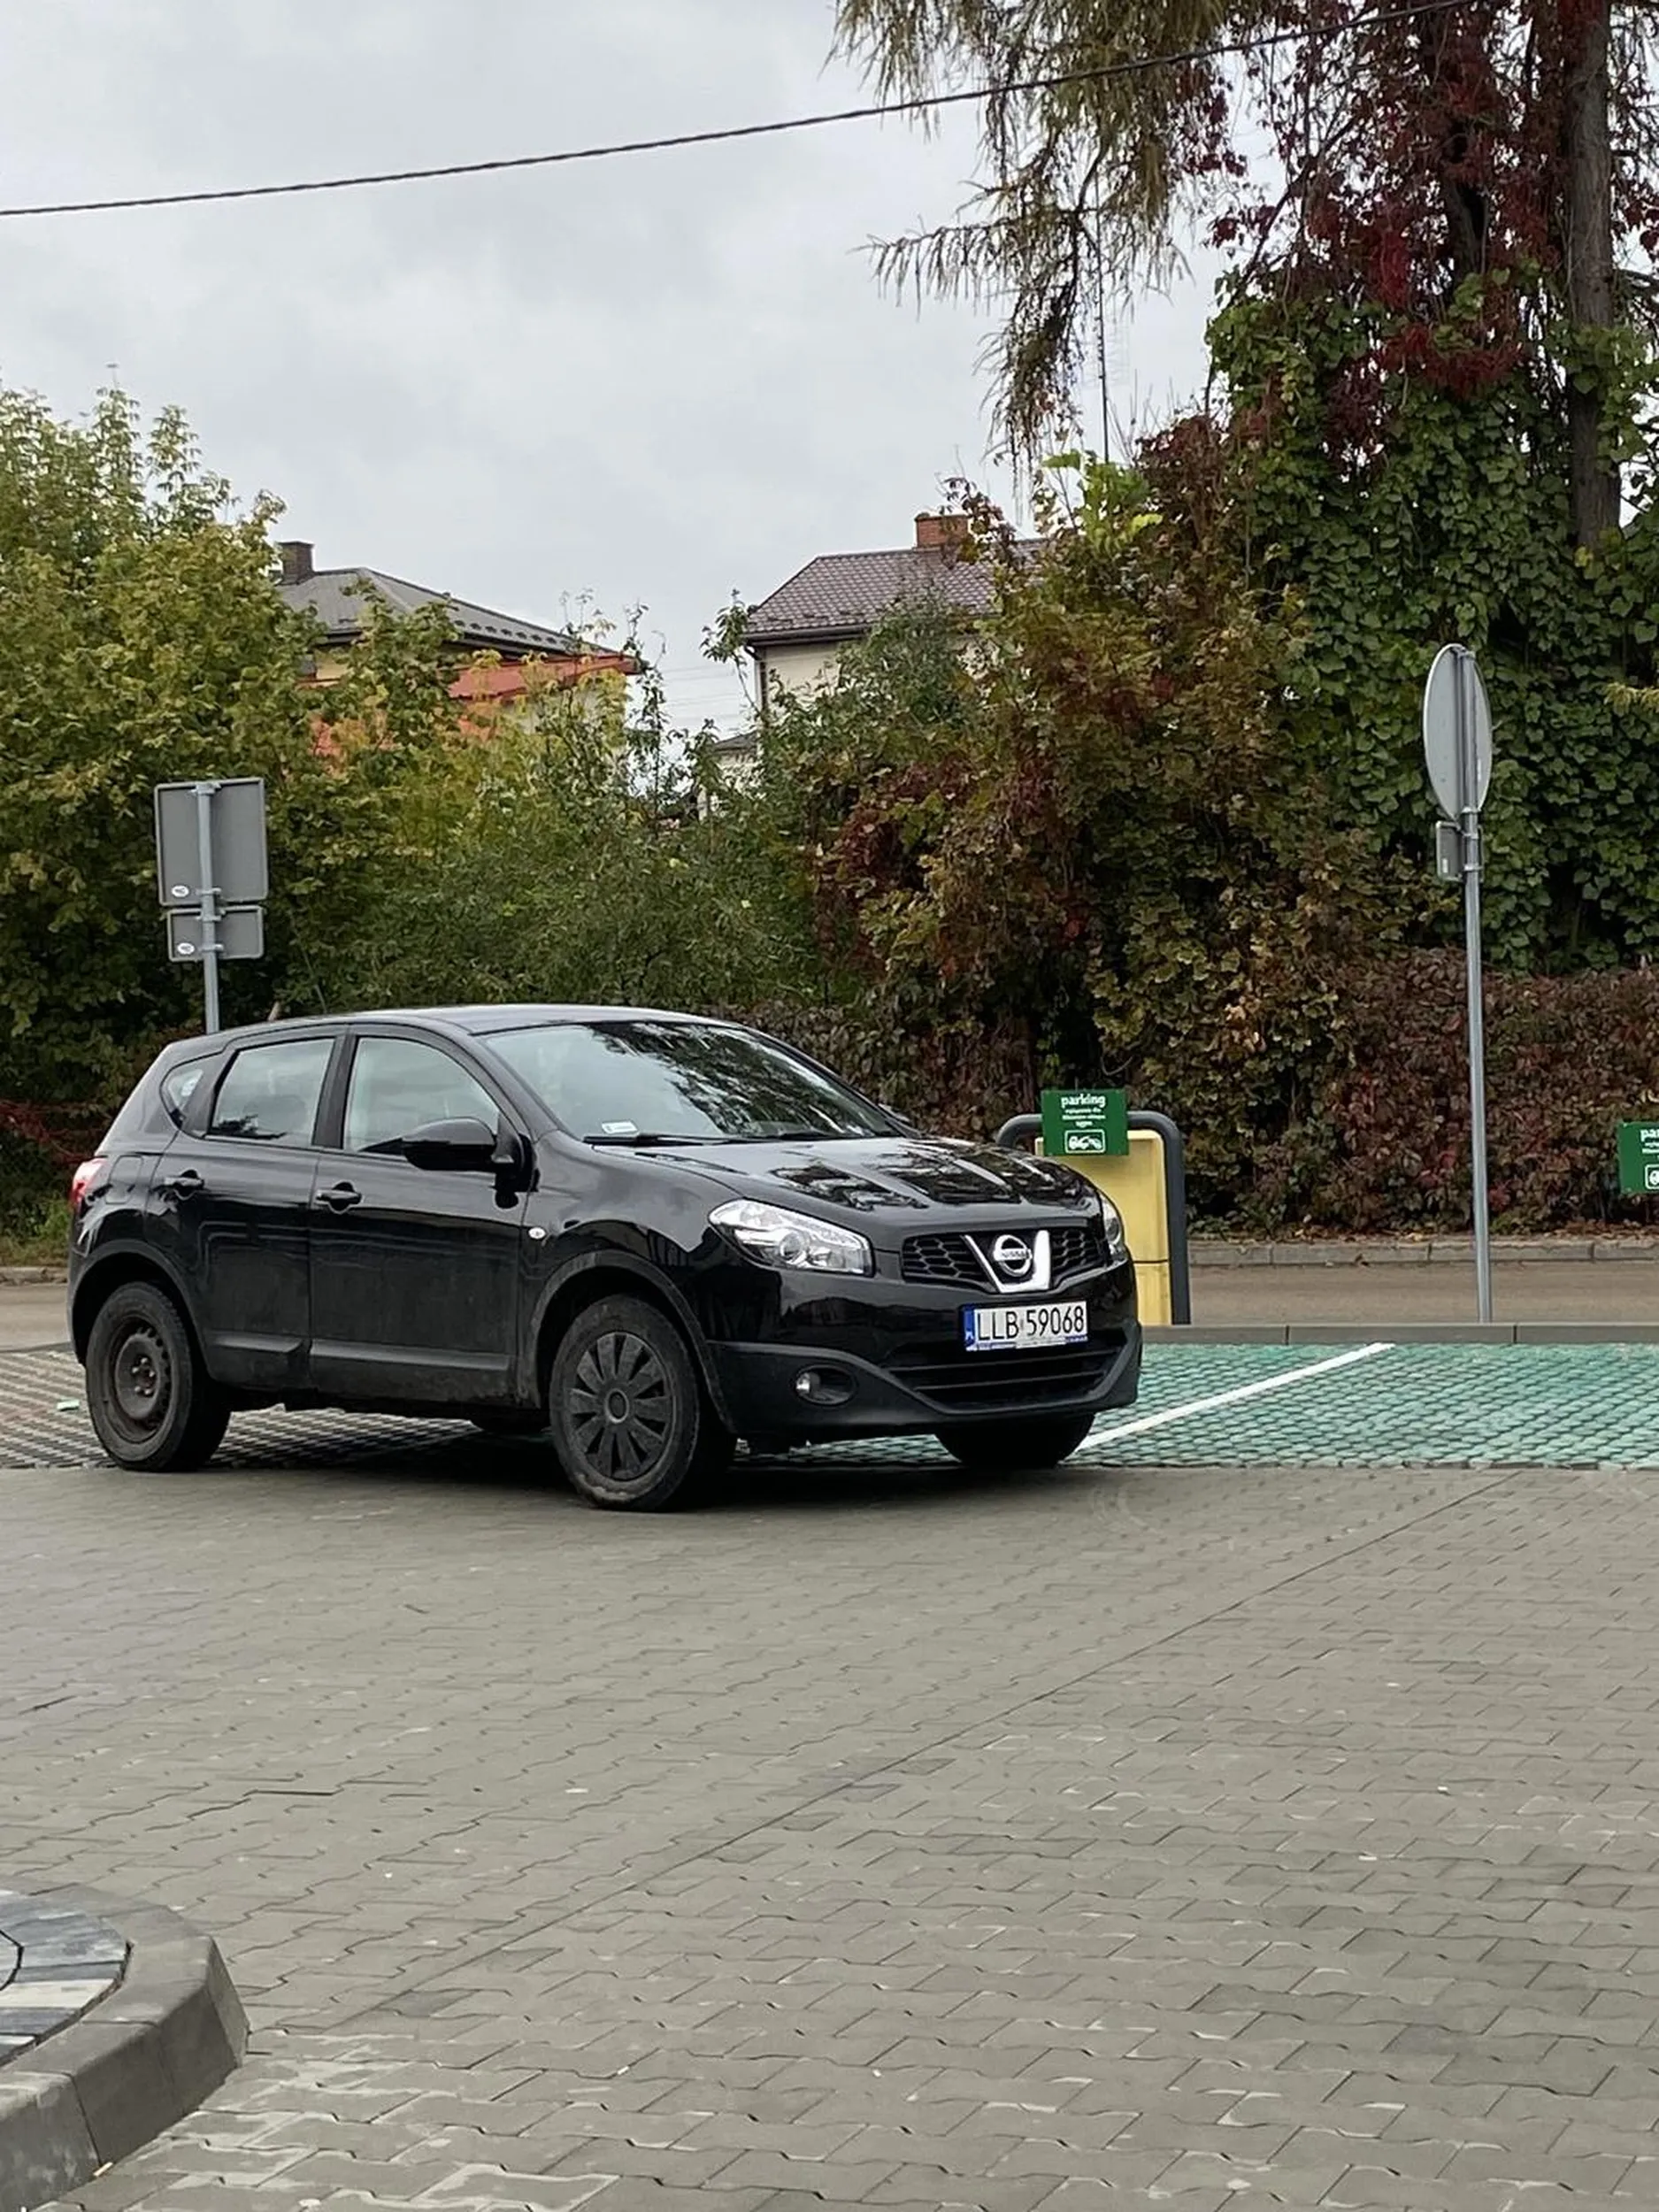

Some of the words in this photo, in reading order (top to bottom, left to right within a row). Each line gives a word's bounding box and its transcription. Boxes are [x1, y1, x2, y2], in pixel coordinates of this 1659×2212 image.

[1061, 1093, 1106, 1109] parking
[978, 1310, 1019, 1340] LLB
[1025, 1305, 1084, 1336] 59068
